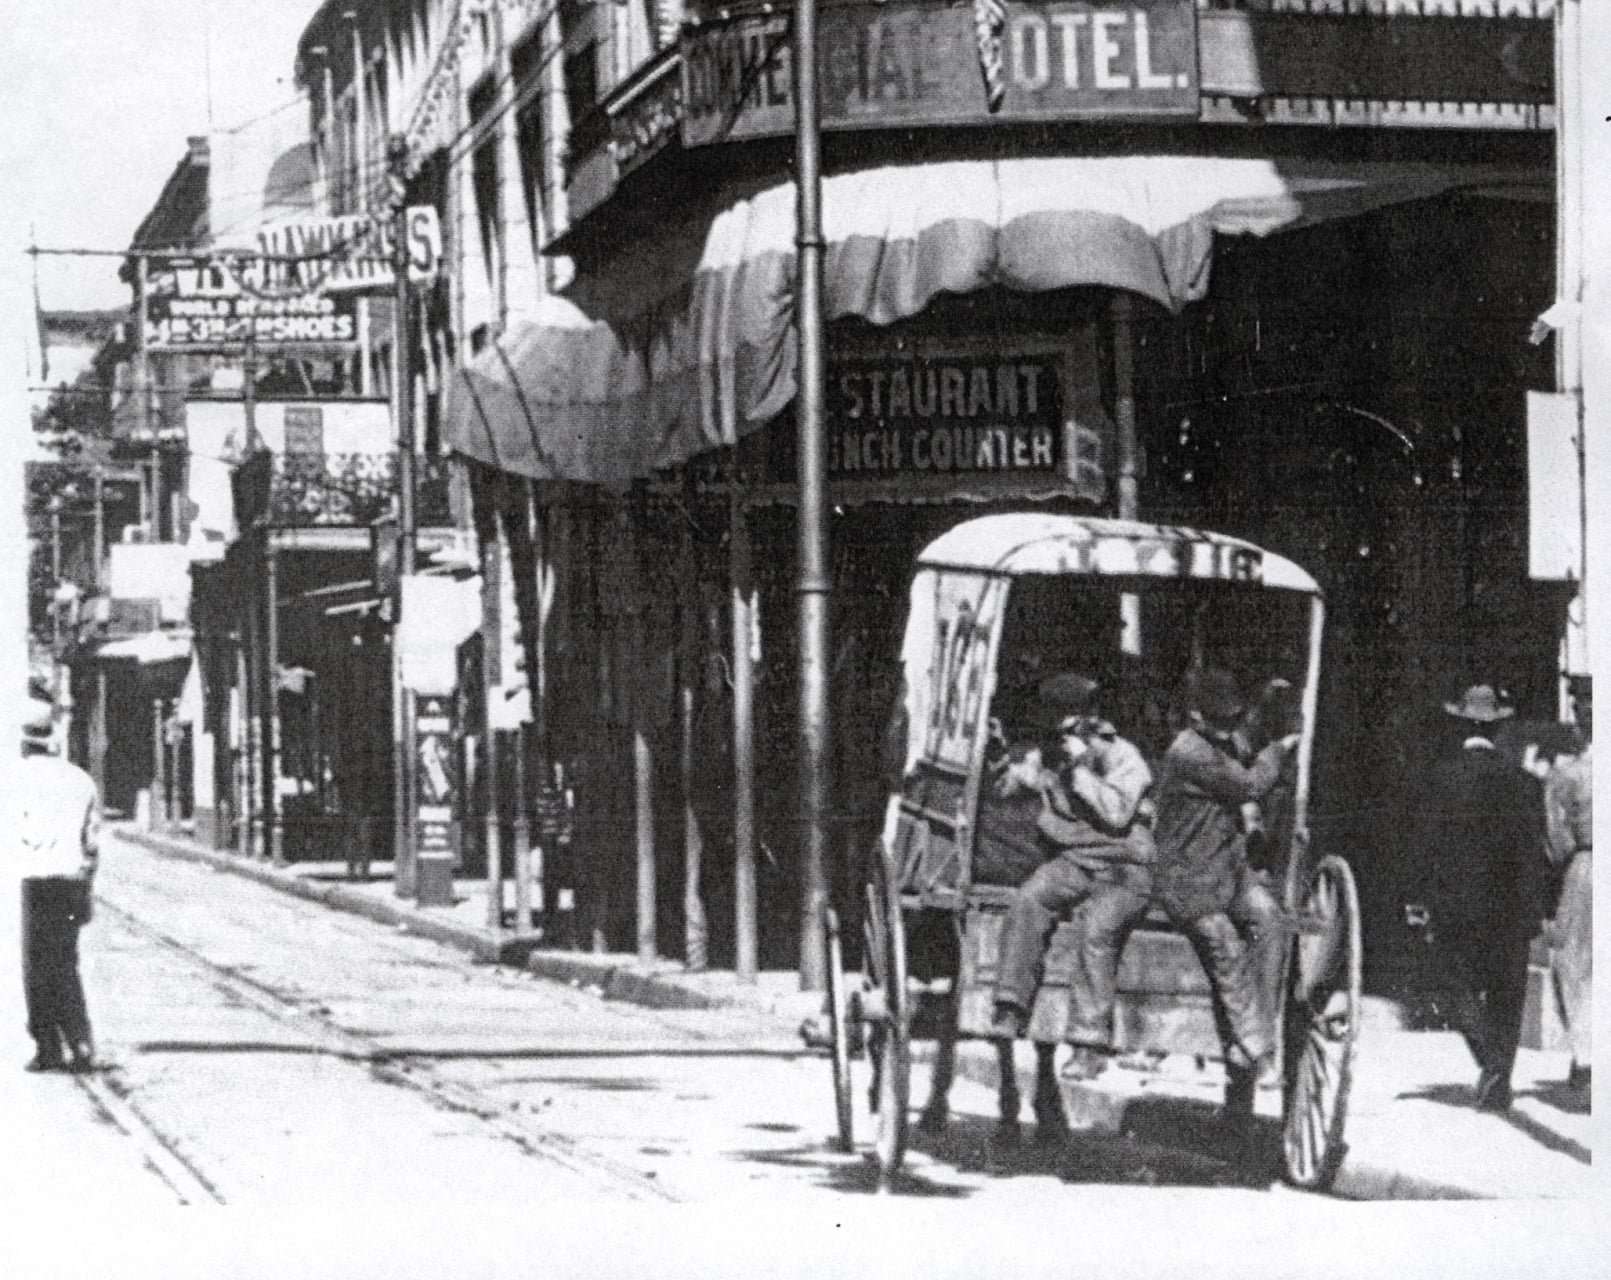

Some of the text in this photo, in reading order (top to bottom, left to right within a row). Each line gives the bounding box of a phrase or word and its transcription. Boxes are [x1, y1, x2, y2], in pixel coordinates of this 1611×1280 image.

[1008, 10, 1189, 91] OTEL.
[836, 364, 1043, 419] STAURANT
[830, 424, 1053, 471] NCH COUNTER
